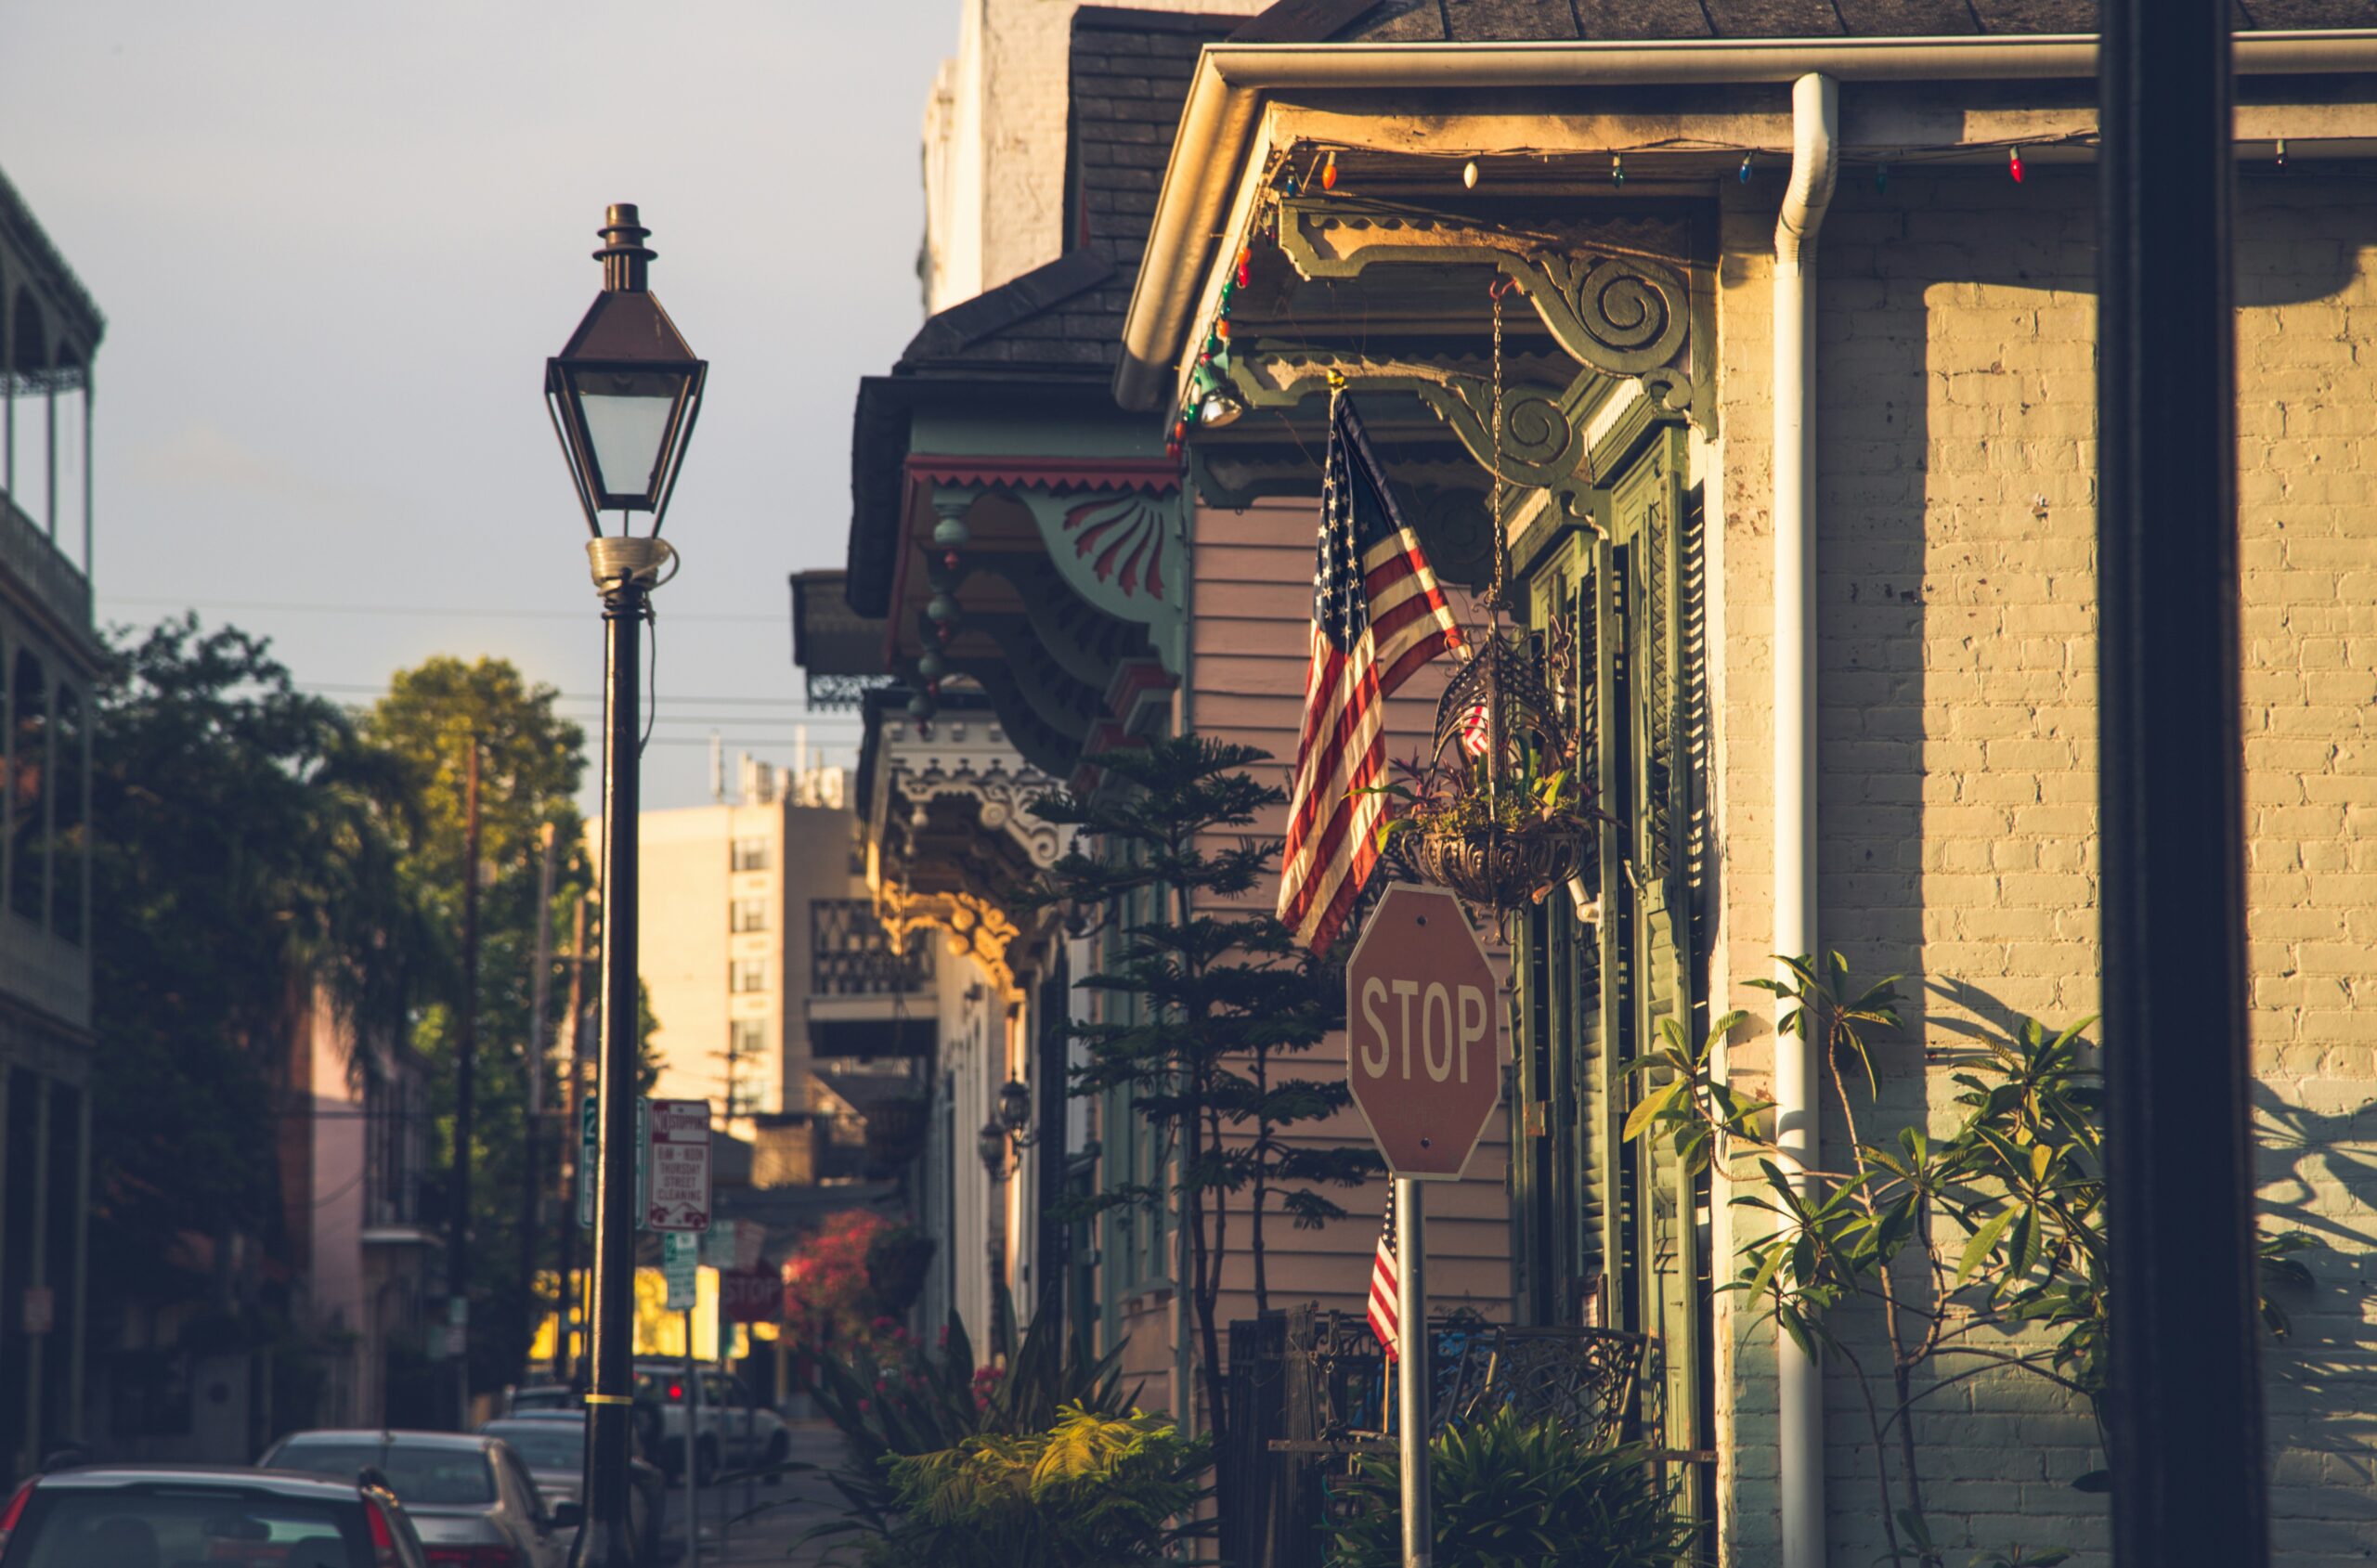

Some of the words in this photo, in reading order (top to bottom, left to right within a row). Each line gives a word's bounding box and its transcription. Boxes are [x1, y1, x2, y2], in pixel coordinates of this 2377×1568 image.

[1360, 976, 1487, 1083] STOP
[654, 1111, 669, 1133] NO
[669, 1114, 708, 1130] STOPPING
[683, 1147, 704, 1161] NOON
[660, 1162, 701, 1175] THURSDAY
[664, 1176, 695, 1188] STREET
[657, 1188, 702, 1202] CLEANING
[725, 1277, 780, 1302] STOP
